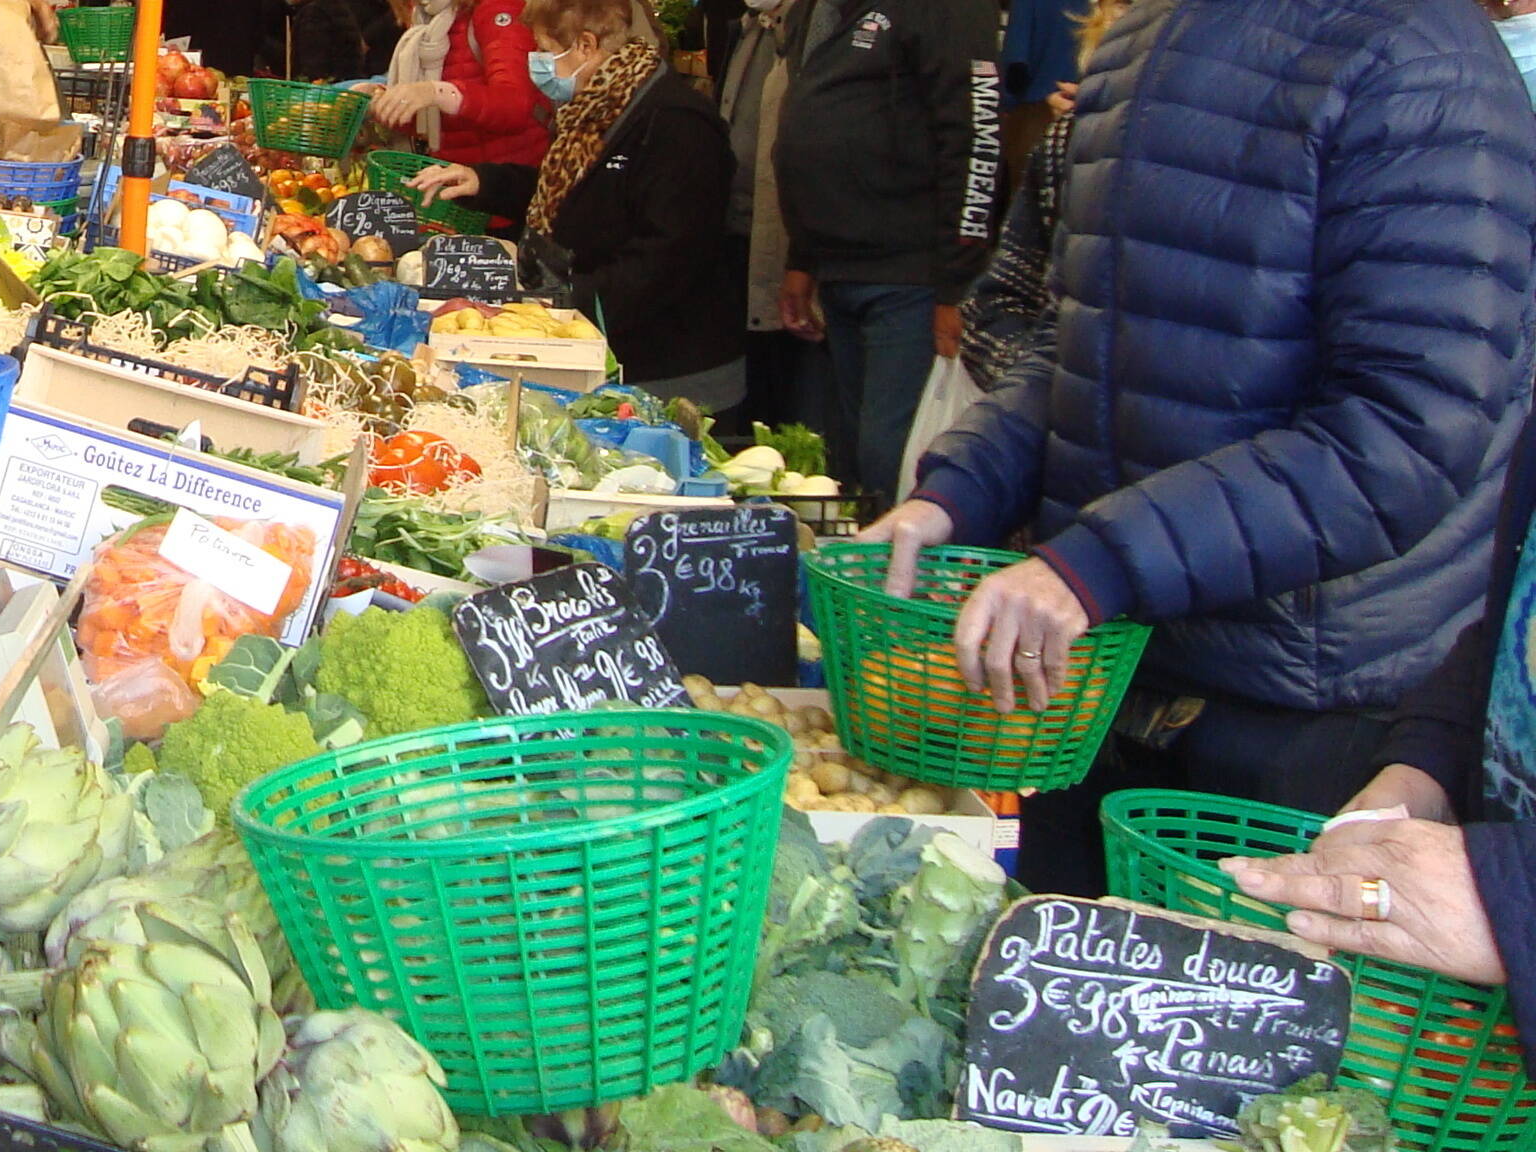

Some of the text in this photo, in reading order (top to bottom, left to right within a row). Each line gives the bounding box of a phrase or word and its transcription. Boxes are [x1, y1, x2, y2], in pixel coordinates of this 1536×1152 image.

[959, 76, 1001, 239] MIAMI BEACH
[83, 445, 263, 514] Goûtez La Difference
[660, 510, 767, 561] Grenailles
[1032, 901, 1164, 972] Patates
[1183, 930, 1297, 996] douces
[1160, 1017, 1275, 1079] Panais
[968, 1063, 1077, 1122] Navets
